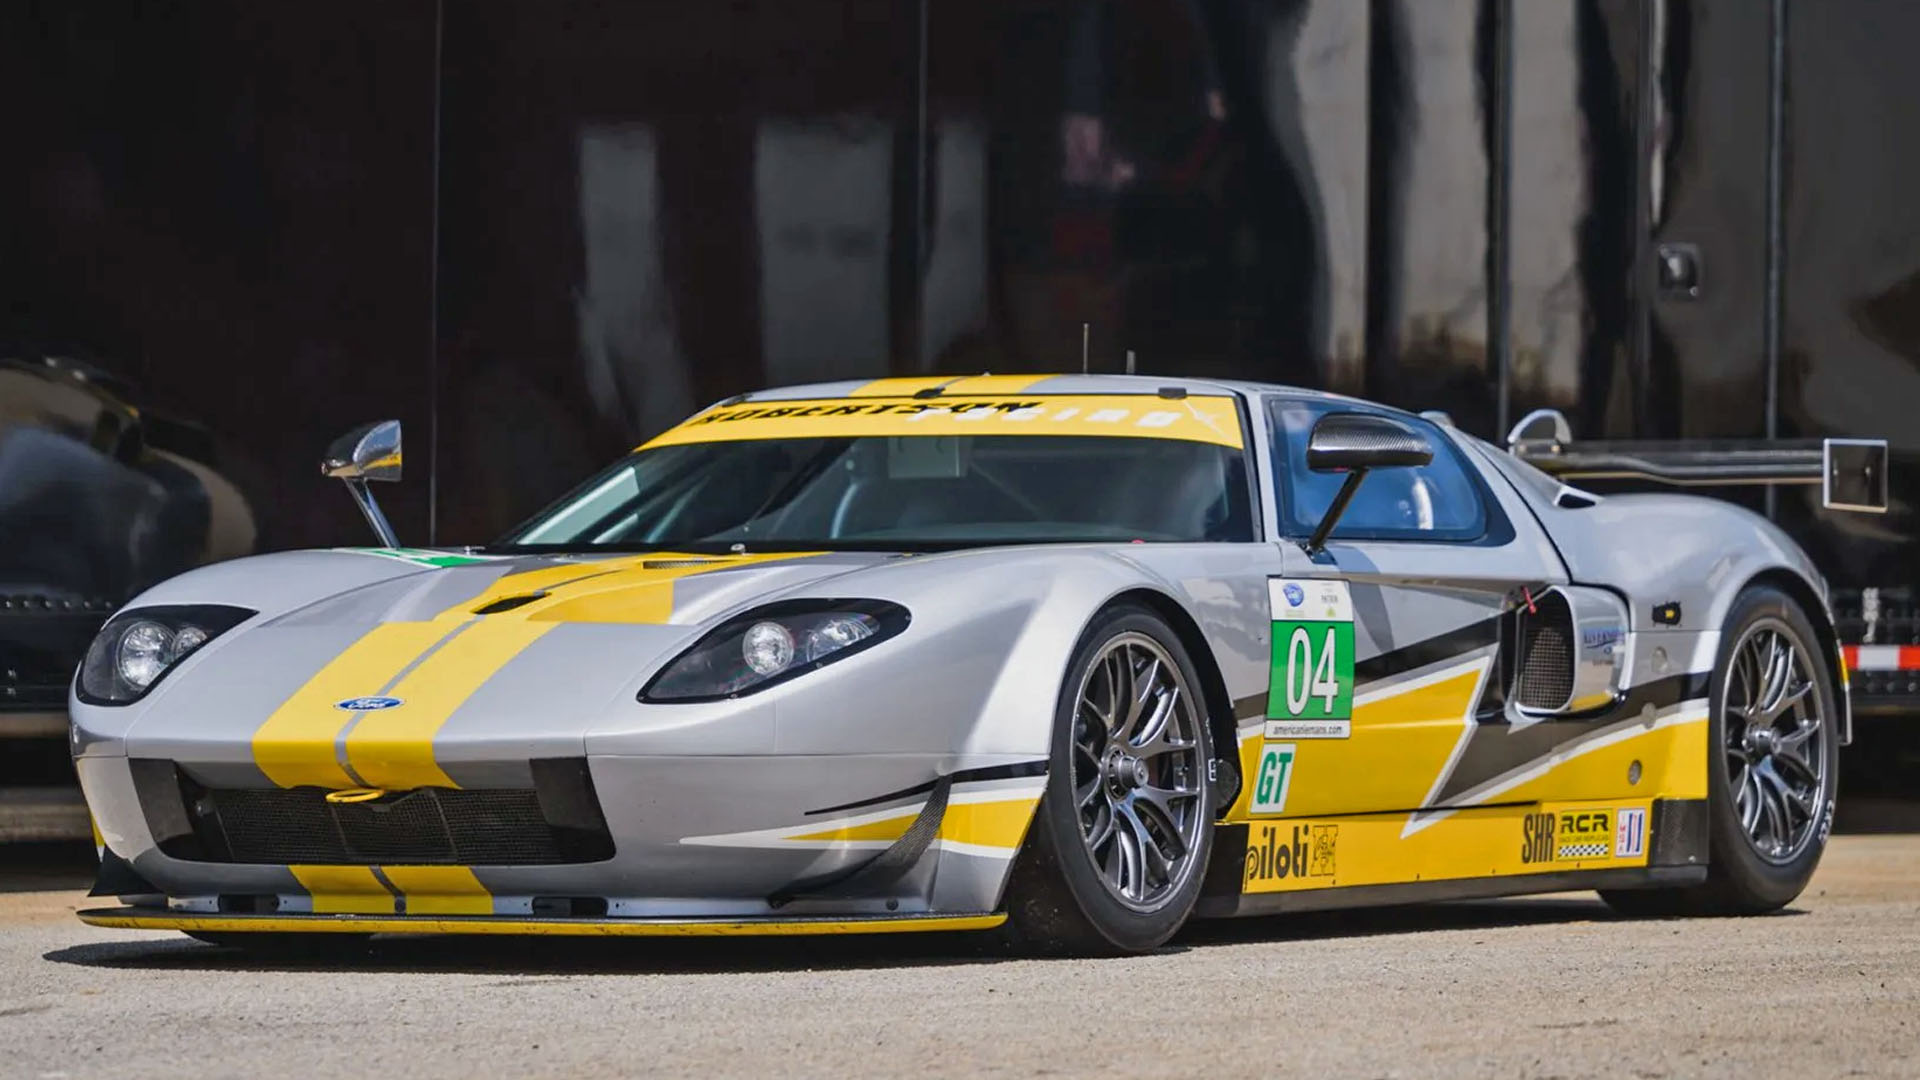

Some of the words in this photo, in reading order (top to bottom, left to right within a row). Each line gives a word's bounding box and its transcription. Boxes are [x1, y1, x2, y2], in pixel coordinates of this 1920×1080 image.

[1286, 625, 1339, 715] 04
[1256, 752, 1292, 804] GT
[1522, 812, 1555, 863] SHR
[1561, 813, 1608, 833] RCR
[1244, 824, 1309, 891] piloti
